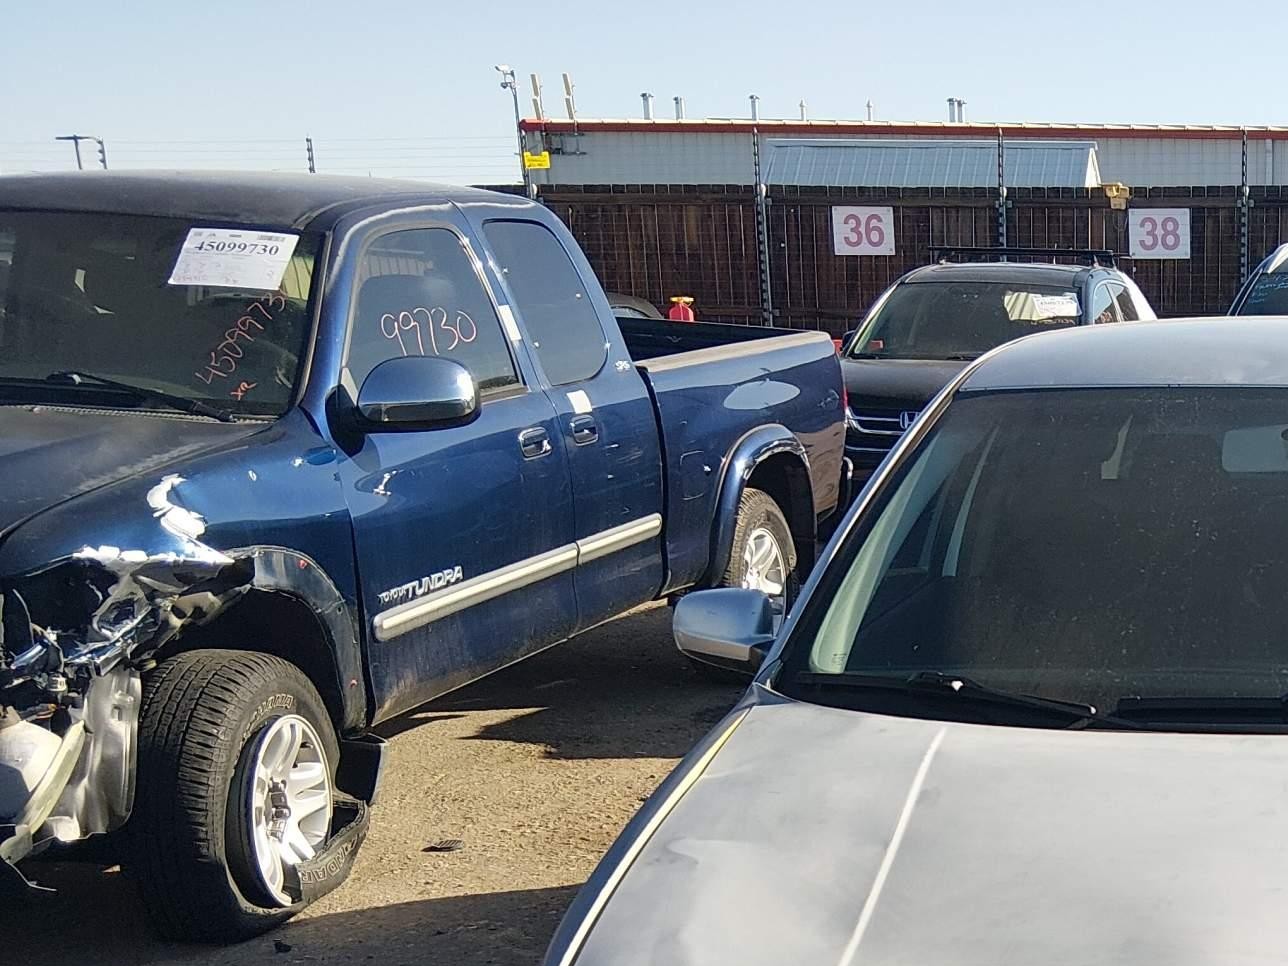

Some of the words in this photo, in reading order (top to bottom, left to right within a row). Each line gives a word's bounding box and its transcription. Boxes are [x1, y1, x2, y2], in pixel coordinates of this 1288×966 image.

[194, 240, 280, 256] 45099730
[844, 213, 885, 248] 36
[1138, 216, 1181, 251] 38
[381, 307, 477, 356] 99730
[406, 565, 464, 599] TUNDRA
